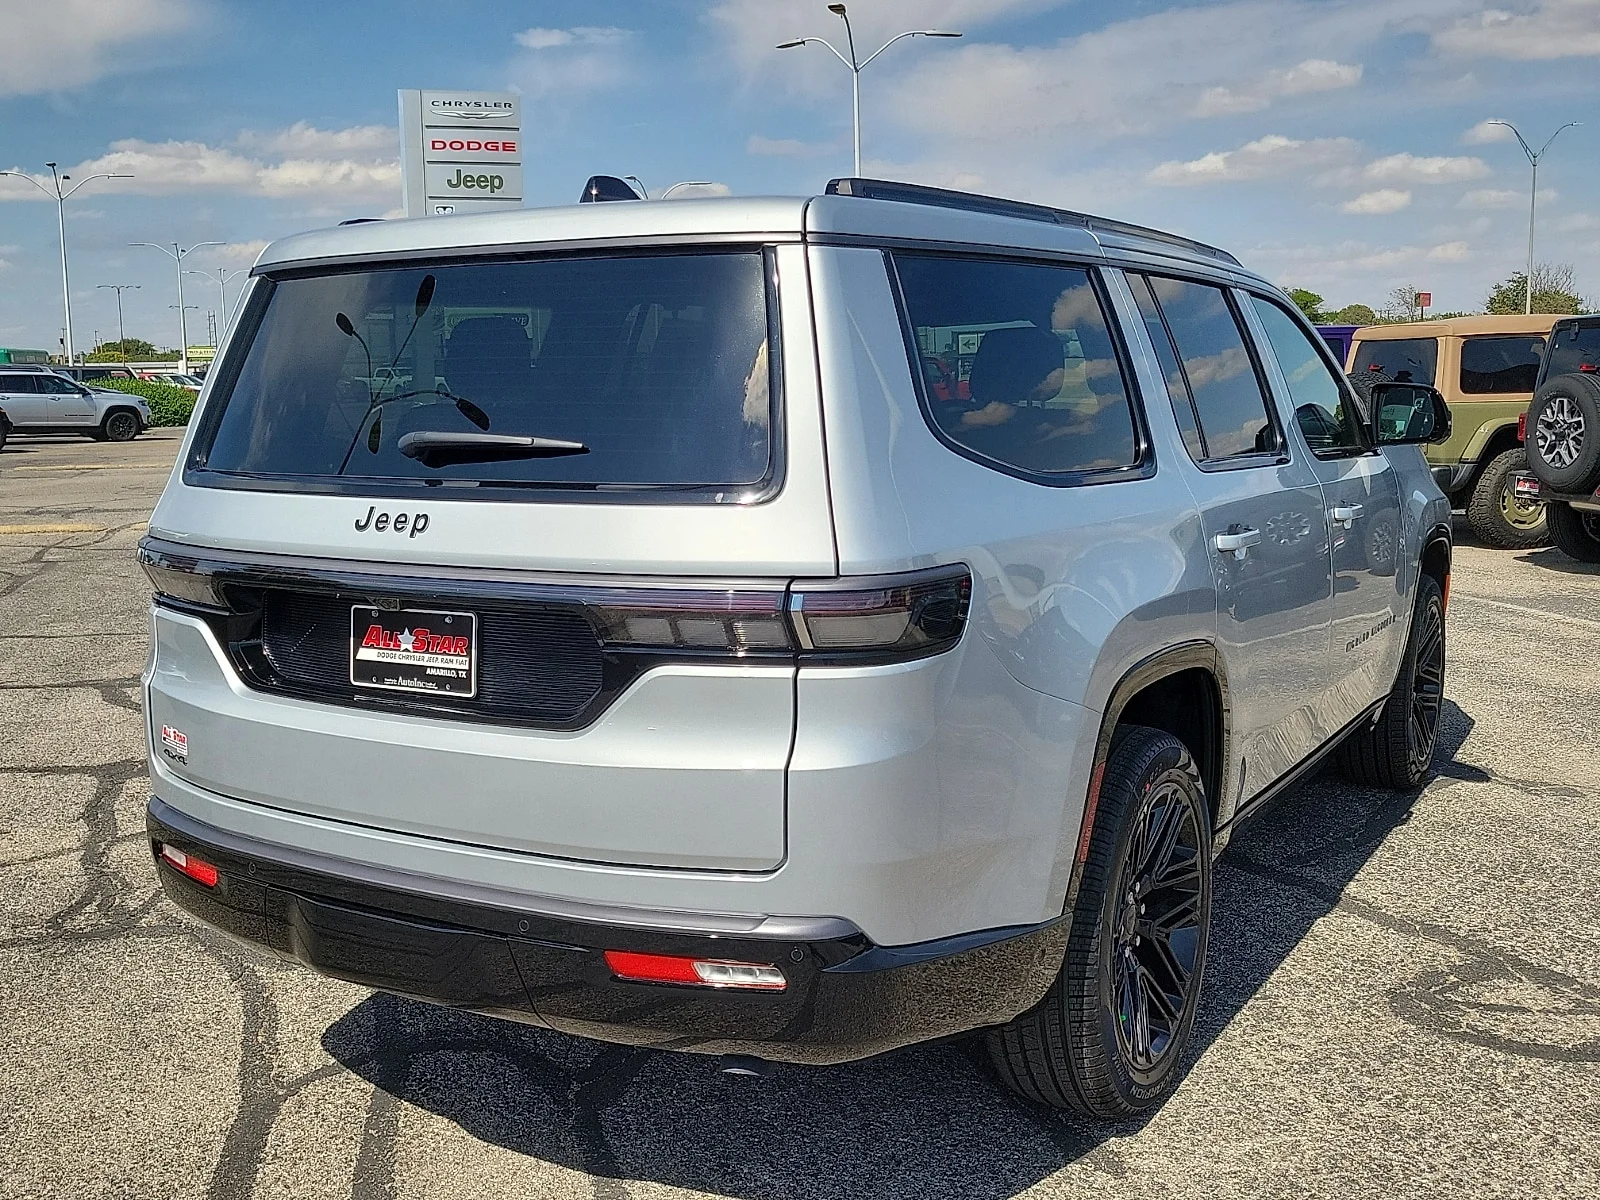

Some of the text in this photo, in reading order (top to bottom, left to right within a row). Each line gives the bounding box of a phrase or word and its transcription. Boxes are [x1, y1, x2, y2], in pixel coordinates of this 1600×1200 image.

[431, 100, 513, 109] CHRYSLER
[431, 140, 517, 152] DODGE
[446, 169, 504, 194] Jeep
[354, 505, 431, 539] Jeep
[411, 627, 469, 656] STAR
[376, 651, 397, 660] DODGE
[397, 653, 425, 663] CHRYSLER
[458, 671, 468, 679] TX
